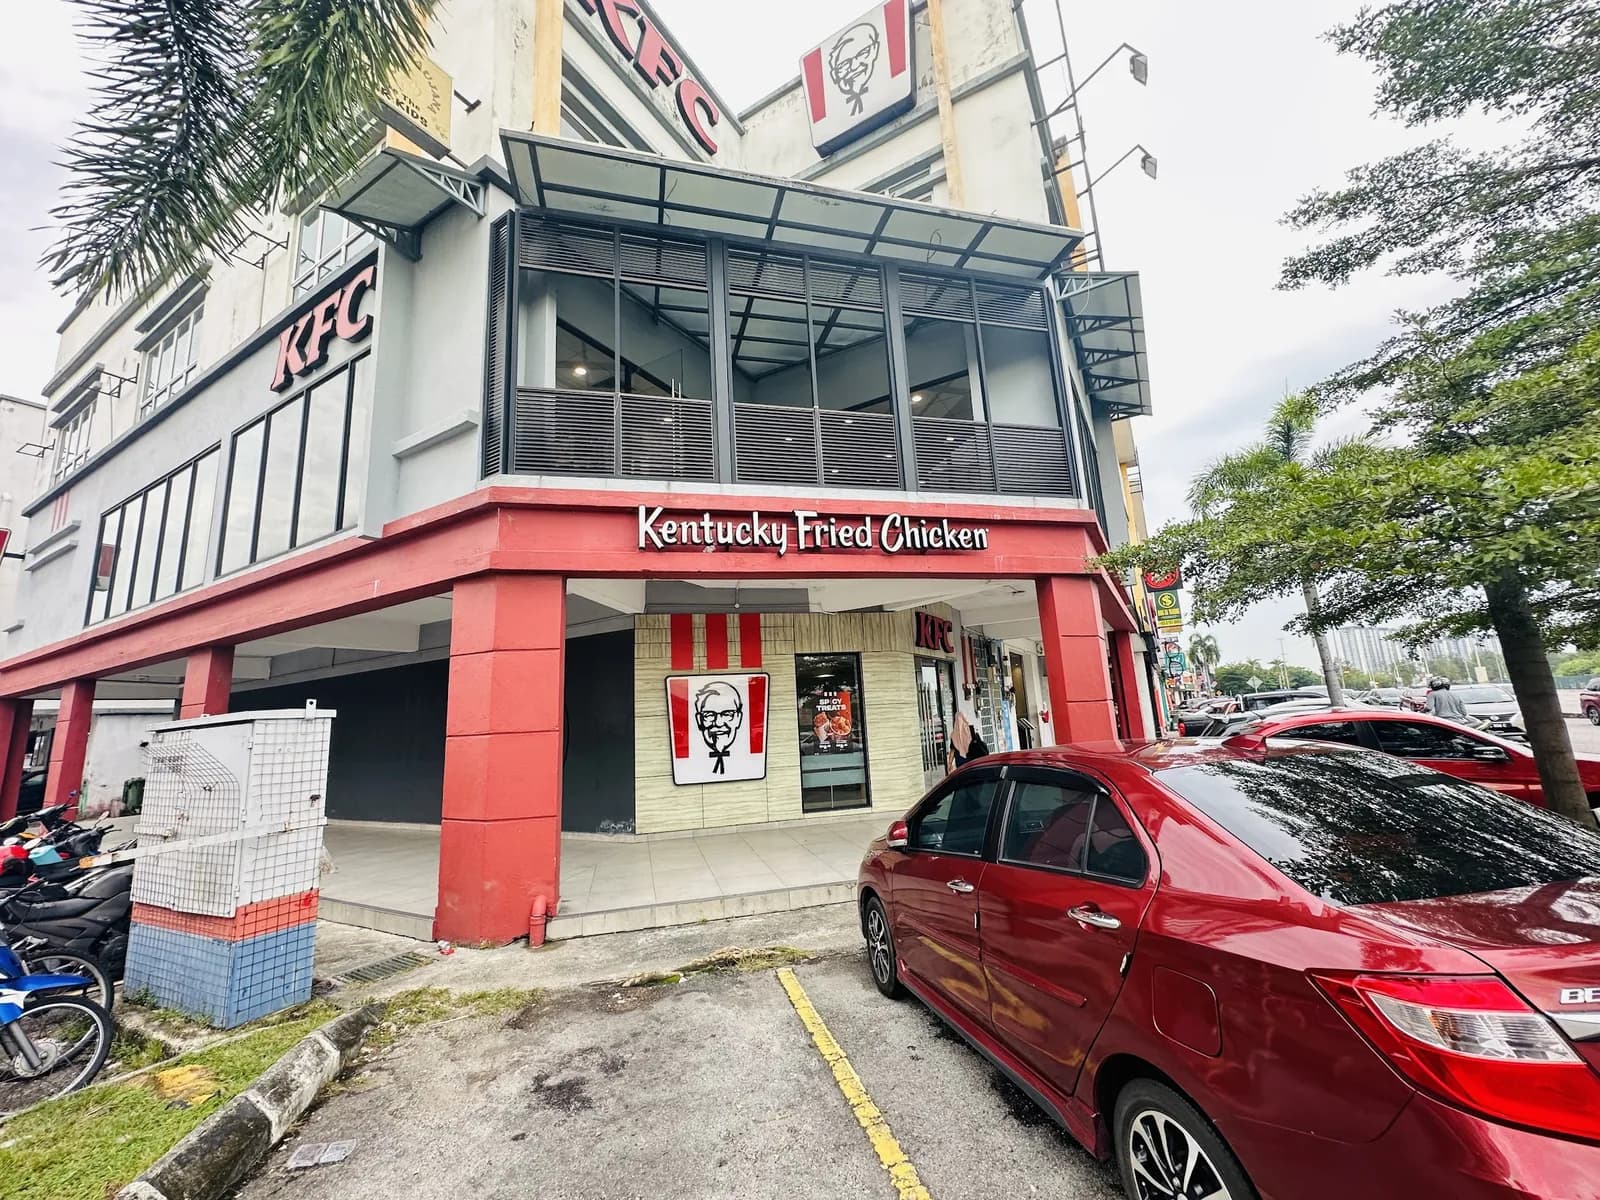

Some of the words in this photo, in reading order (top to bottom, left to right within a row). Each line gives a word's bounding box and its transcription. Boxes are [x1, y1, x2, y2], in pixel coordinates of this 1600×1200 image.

[395, 98, 428, 127] KIDS
[270, 264, 377, 393] KFC
[637, 504, 788, 557] Kentucky
[793, 509, 873, 551] Fried
[879, 512, 989, 553] Chicken
[915, 611, 954, 653] KFC
